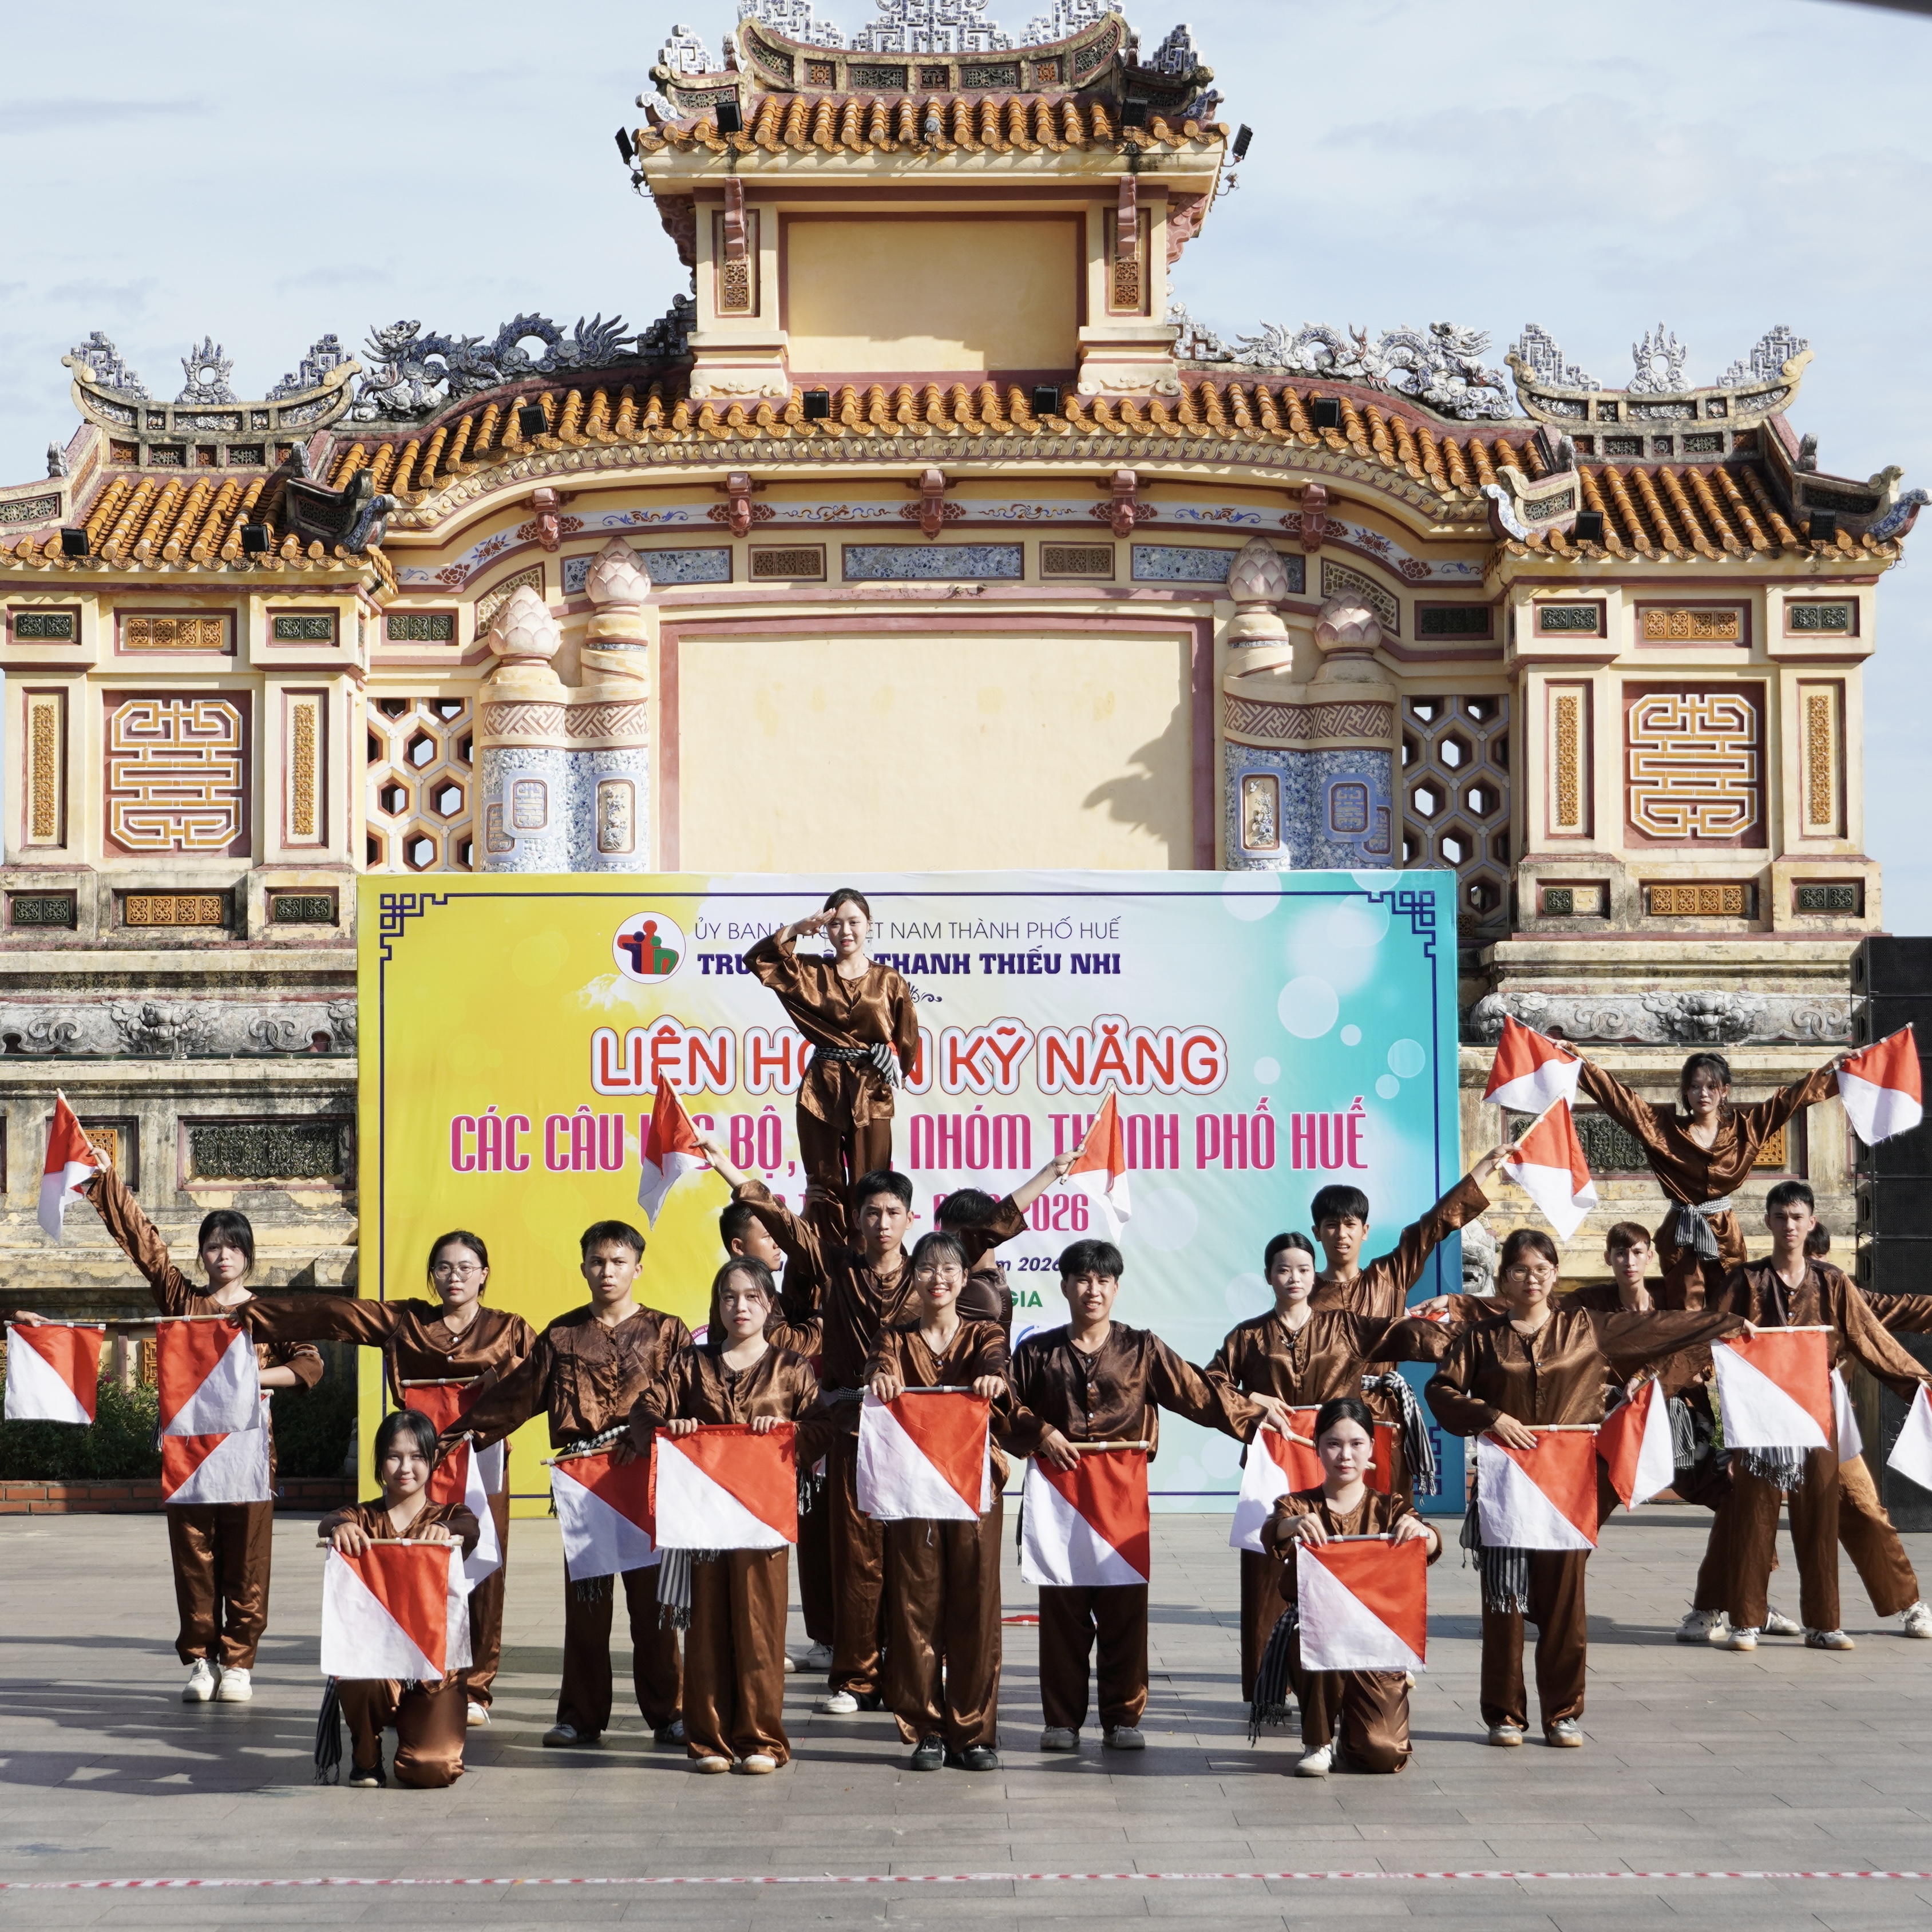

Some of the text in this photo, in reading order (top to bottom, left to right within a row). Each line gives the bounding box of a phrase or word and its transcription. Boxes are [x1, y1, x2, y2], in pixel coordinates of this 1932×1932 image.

[695, 917, 721, 939] ỦY
[729, 923, 771, 939] BAN
[891, 922, 941, 939] NAM
[948, 918, 1019, 939] THÀNH
[1027, 916, 1072, 939] PHỐ
[1080, 916, 1121, 939] HUẾ
[697, 945, 1121, 975] TRU THANH THIẾU NHI
[596, 1020, 731, 1090] LIÊN
[945, 1022, 1030, 1090] KỸ
[1042, 1019, 1222, 1090] NĂNG
[450, 1105, 530, 1171] CÁC
[544, 1104, 624, 1171] CÂU
[730, 1104, 795, 1178] BỘ,
[909, 1104, 1032, 1170] NHÓM
[1195, 1096, 1276, 1170] PHỐ
[1290, 1096, 1369, 1169] HUẾ
